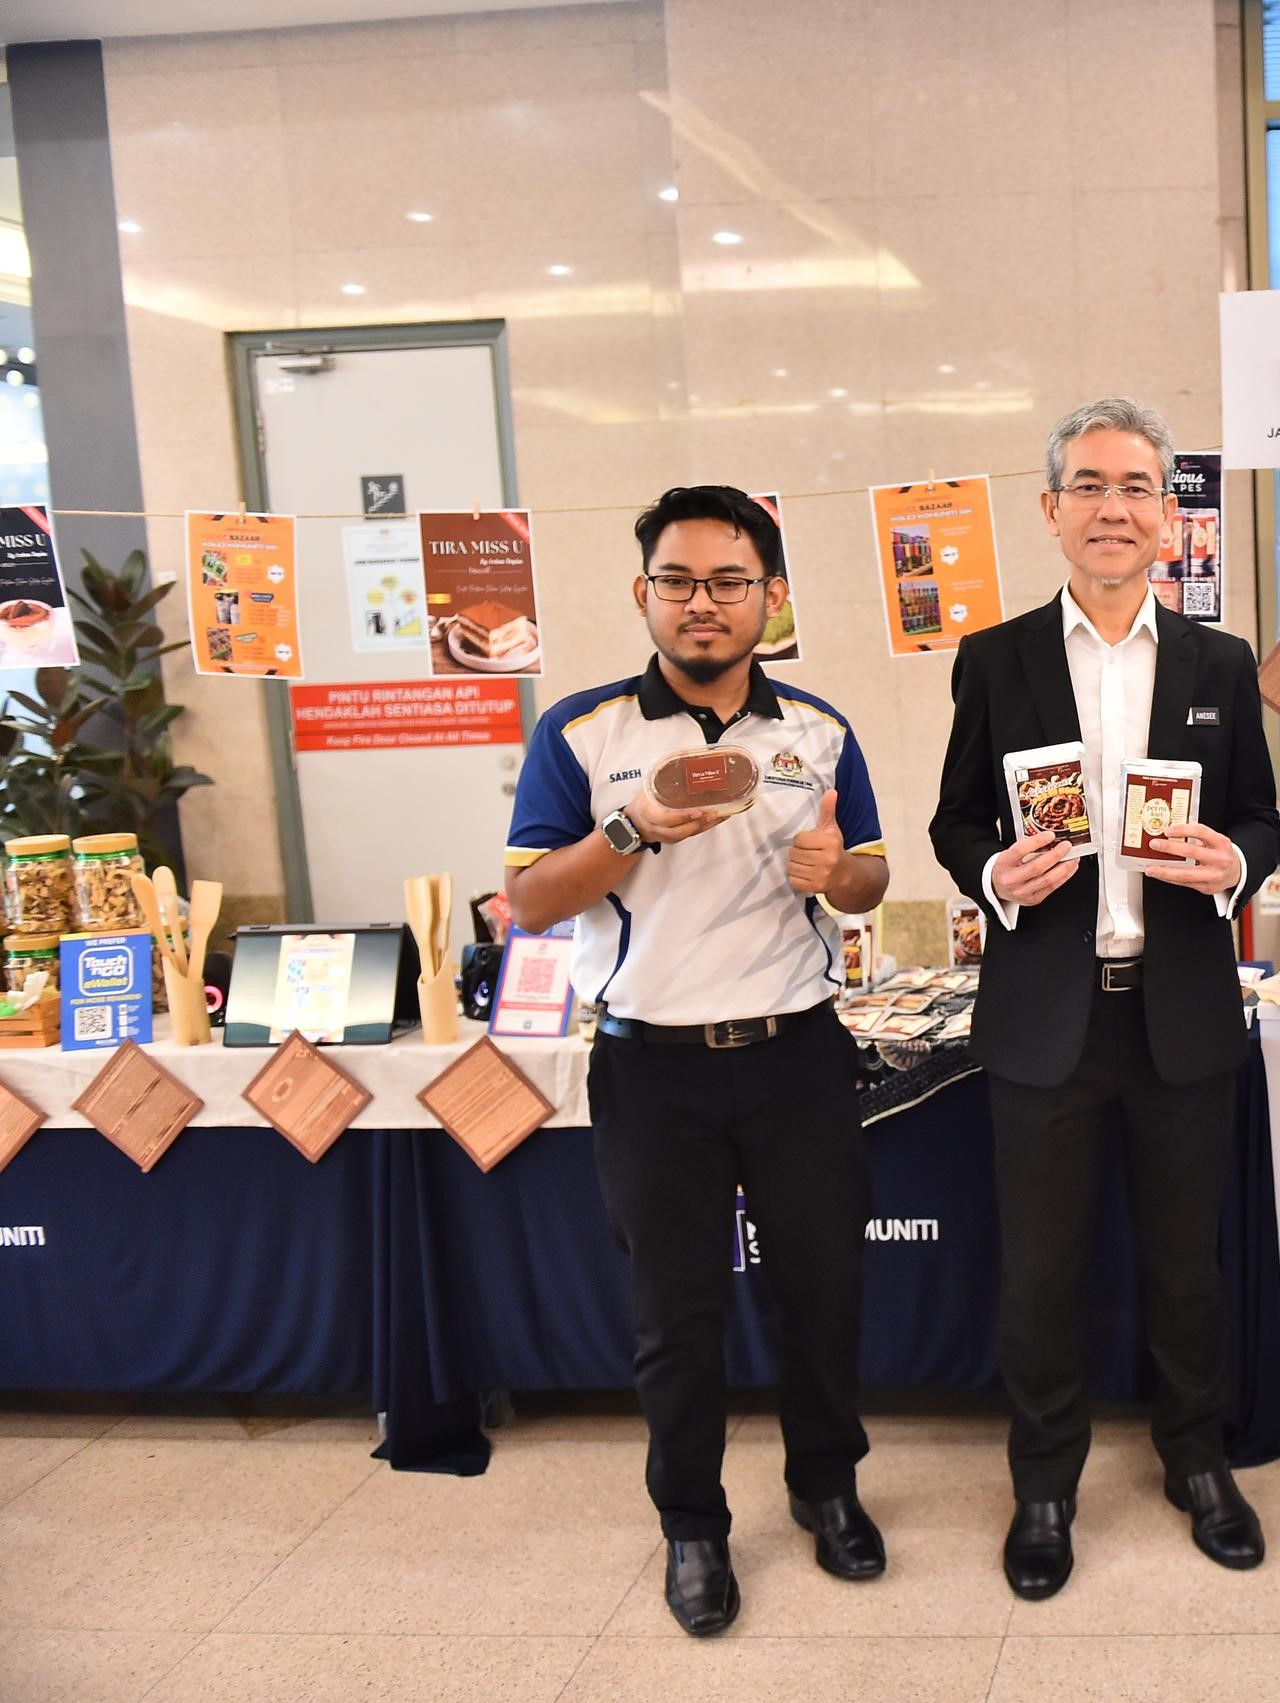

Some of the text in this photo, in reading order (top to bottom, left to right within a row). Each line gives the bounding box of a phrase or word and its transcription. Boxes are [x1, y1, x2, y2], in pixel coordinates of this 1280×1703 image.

[1180, 484, 1202, 492] PES
[35, 534, 46, 546] U
[429, 540, 523, 555] TIRA MISS U
[328, 685, 480, 704] PINTU RINTANGAN API
[385, 702, 452, 717] SENTIASA
[455, 699, 515, 715] DITUTUP
[609, 769, 642, 783] SAREH
[84, 954, 128, 967] Touch
